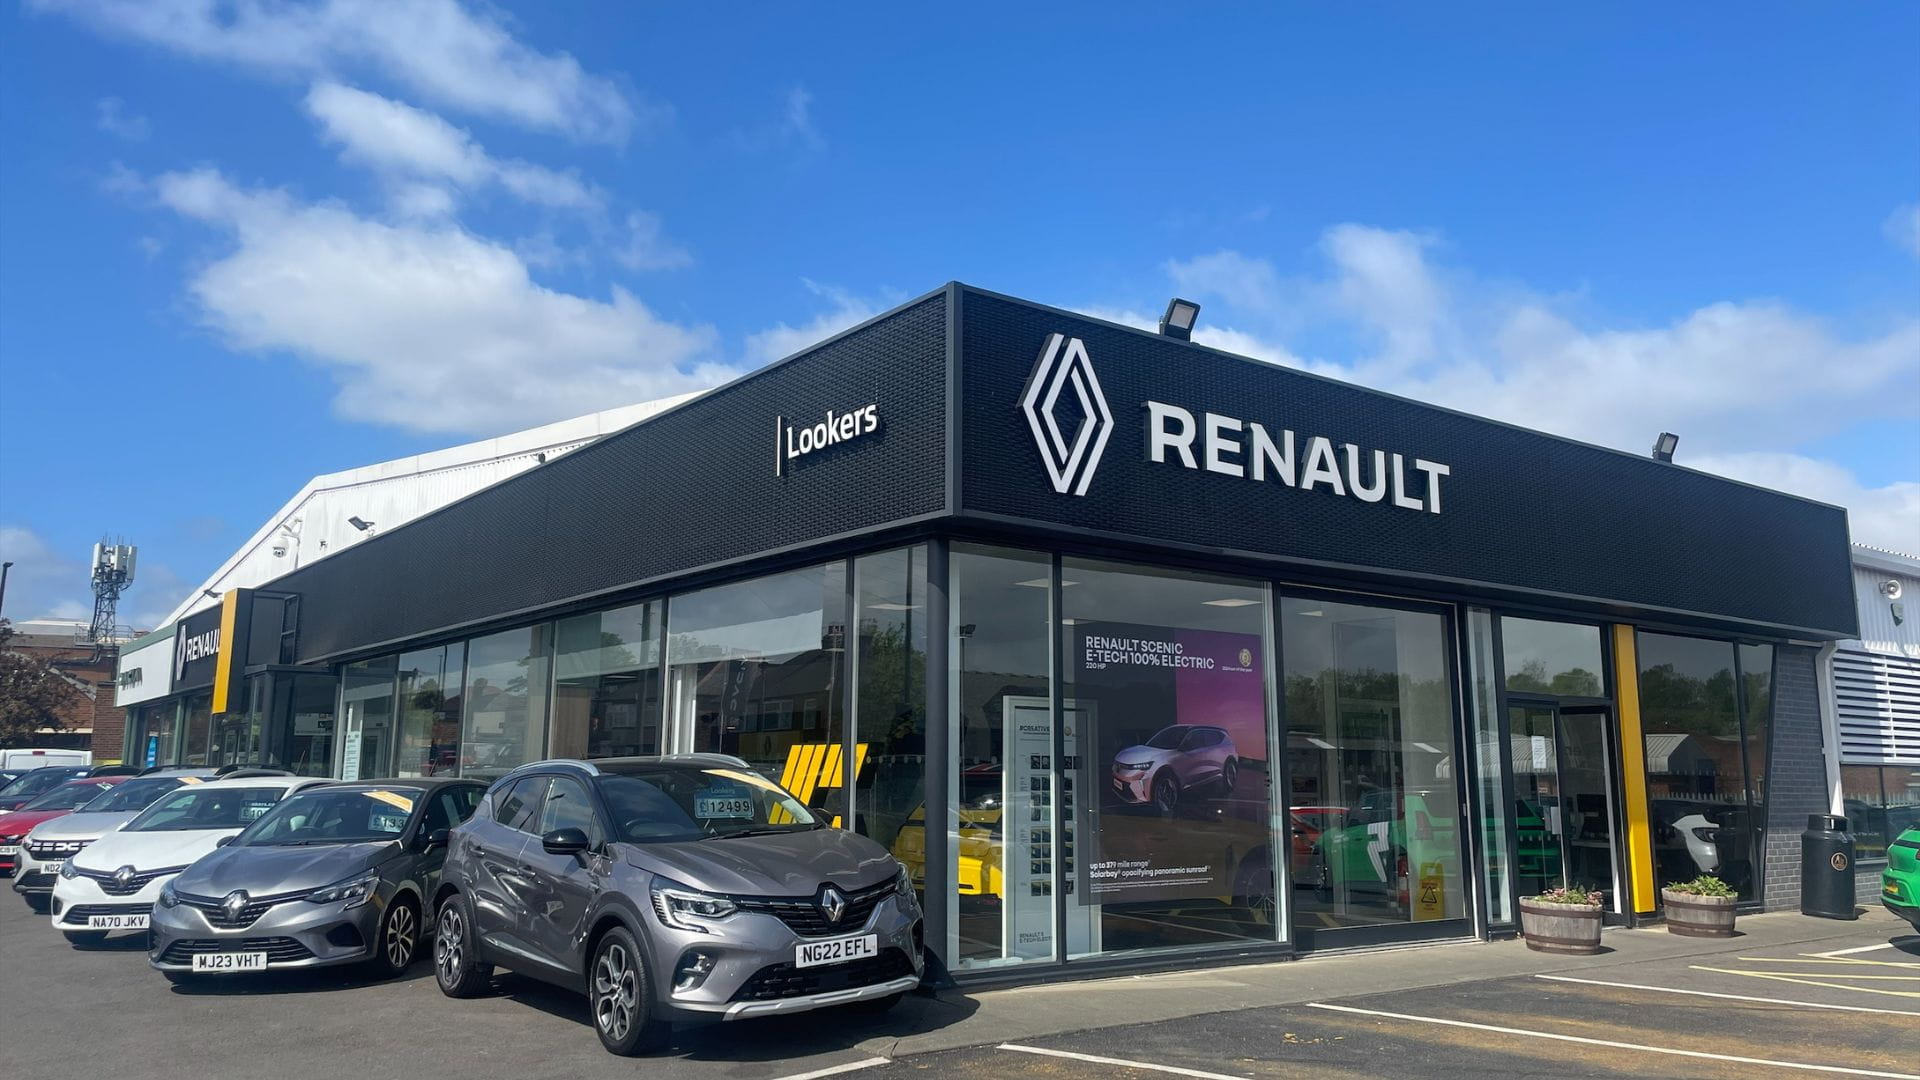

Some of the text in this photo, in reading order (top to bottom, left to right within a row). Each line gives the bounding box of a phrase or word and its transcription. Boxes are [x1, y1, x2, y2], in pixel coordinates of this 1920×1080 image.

[787, 404, 878, 459] Lookers
[1144, 400, 1450, 514] RENAULT
[1085, 635, 1183, 655] RENAULT SCENIC
[1085, 649, 1215, 670] E-TECH 100% ELECTRIC
[1085, 661, 1107, 670] 220 HP
[700, 801, 750, 813] £12499
[1089, 863, 1098, 871] up
[1121, 868, 1154, 878] opacifying
[1154, 866, 1186, 876] panoramic
[93, 915, 145, 927] NA70 JKV
[803, 938, 871, 963] NG22 EFL
[199, 954, 261, 968] MJ23 VHT
